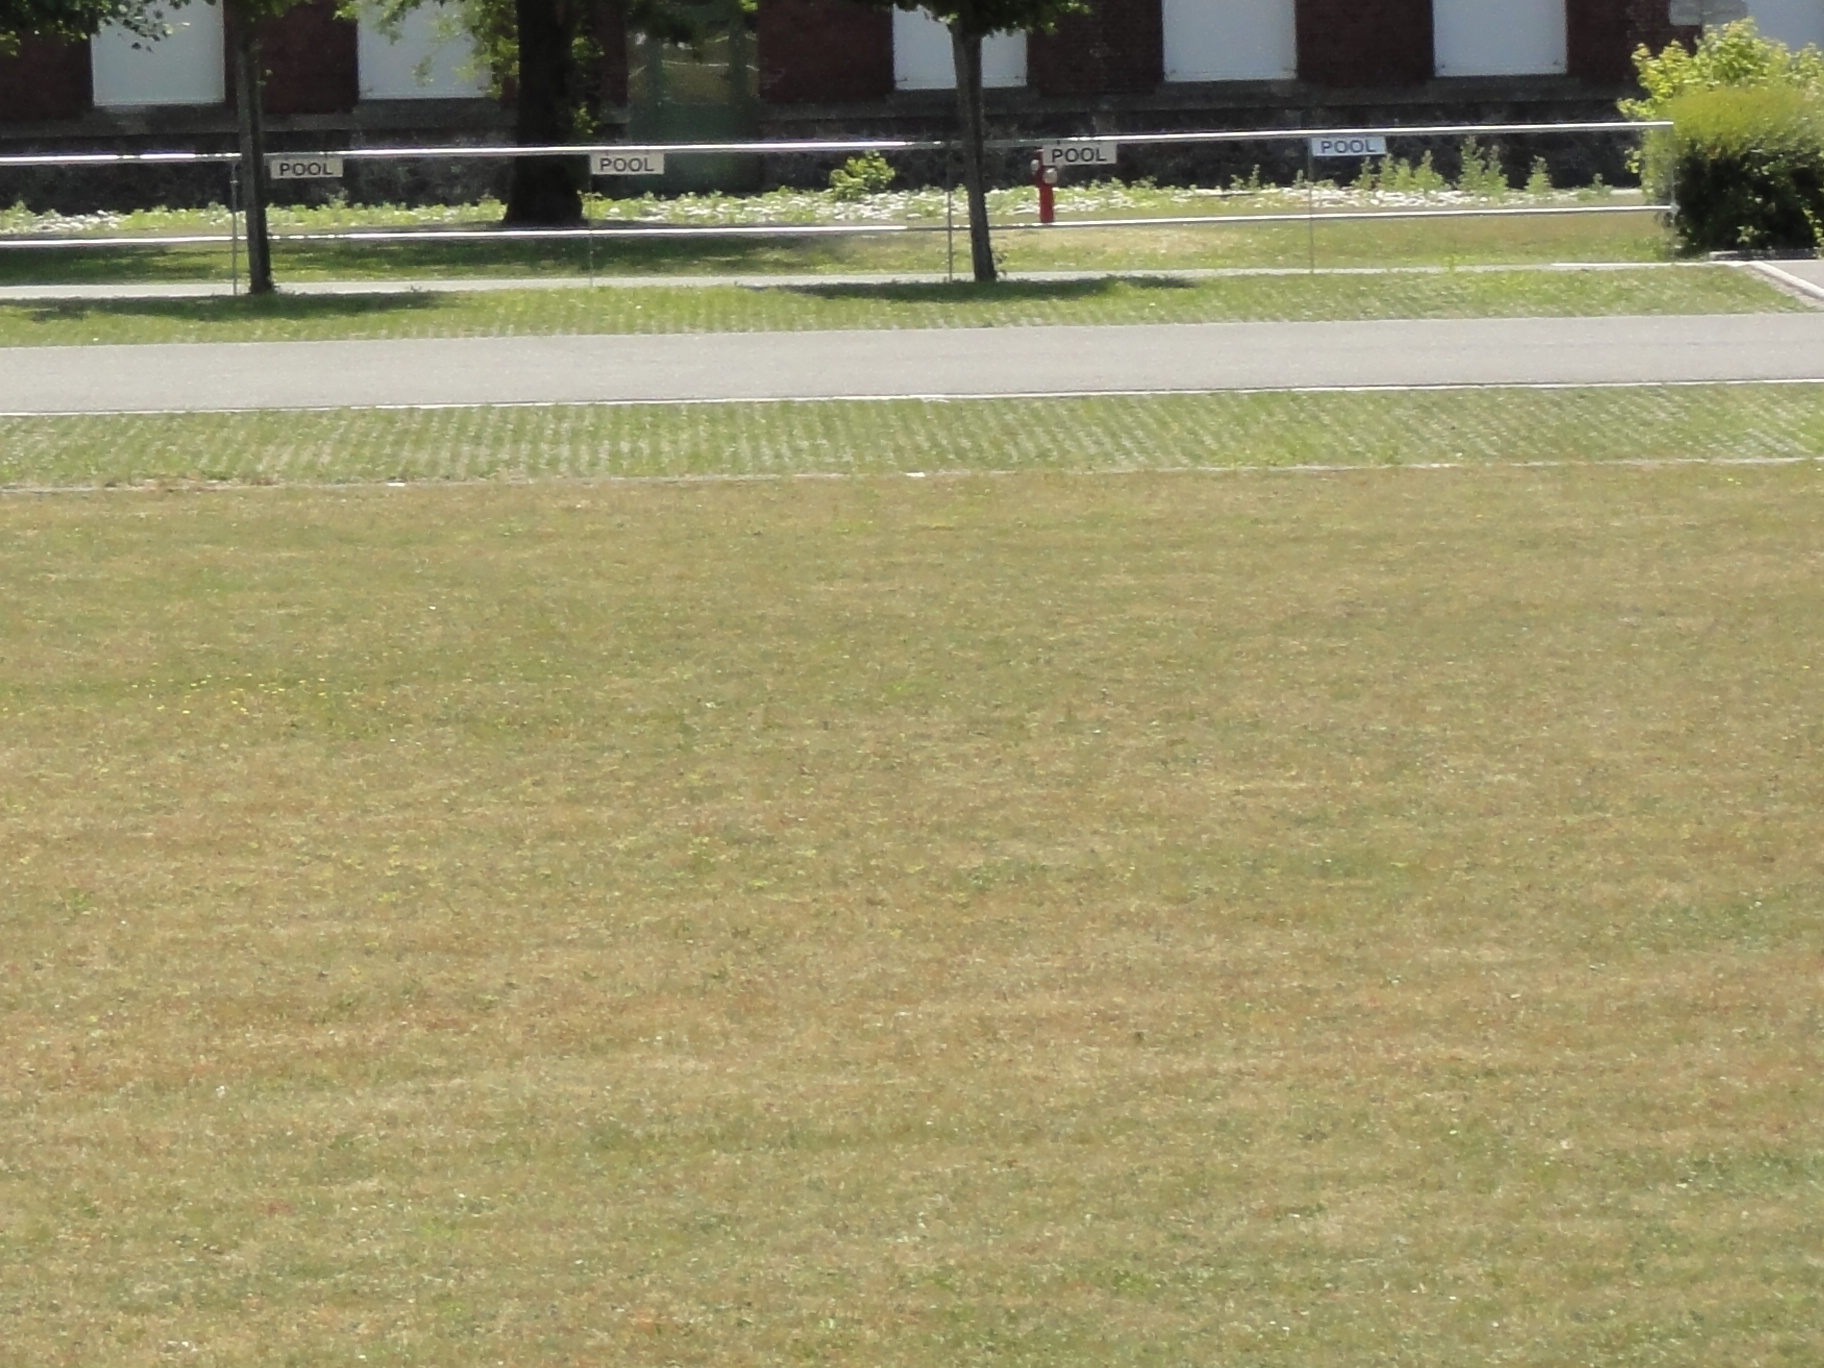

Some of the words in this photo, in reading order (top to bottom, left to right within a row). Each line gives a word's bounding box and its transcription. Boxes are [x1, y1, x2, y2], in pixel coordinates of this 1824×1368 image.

[1321, 139, 1377, 154] POOL
[1051, 147, 1107, 163] POOL
[279, 161, 333, 177] POOL
[599, 157, 654, 172] POOL
